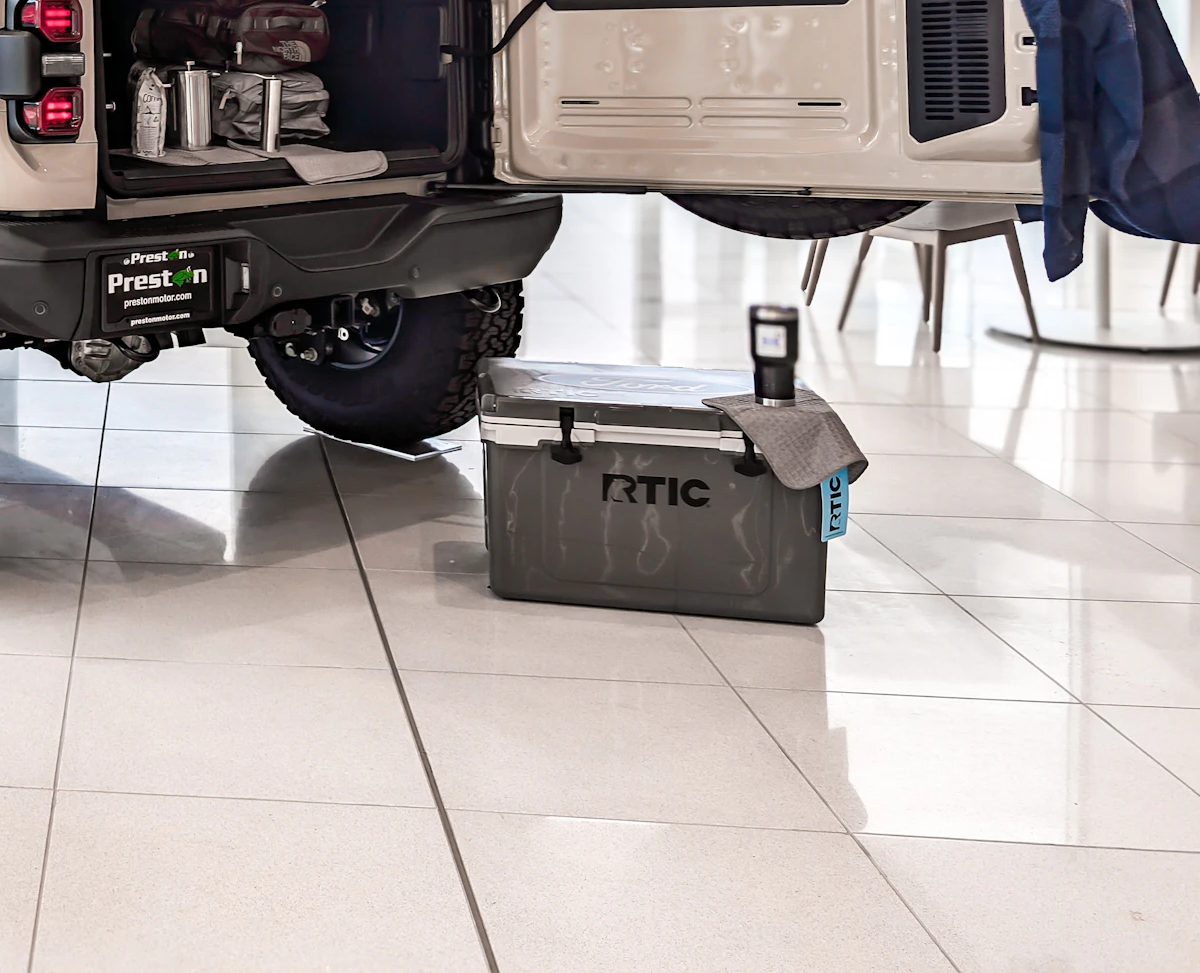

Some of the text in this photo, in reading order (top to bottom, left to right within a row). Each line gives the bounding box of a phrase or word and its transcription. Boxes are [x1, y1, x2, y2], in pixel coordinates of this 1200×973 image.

[272, 46, 299, 54] NORTH
[283, 52, 300, 62] FACE
[124, 292, 192, 309] prestonmotor.com
[130, 312, 190, 326] prestonmotor.com
[580, 376, 708, 392] Ford
[602, 473, 711, 507] RTIC
[829, 476, 842, 532] RTIC
